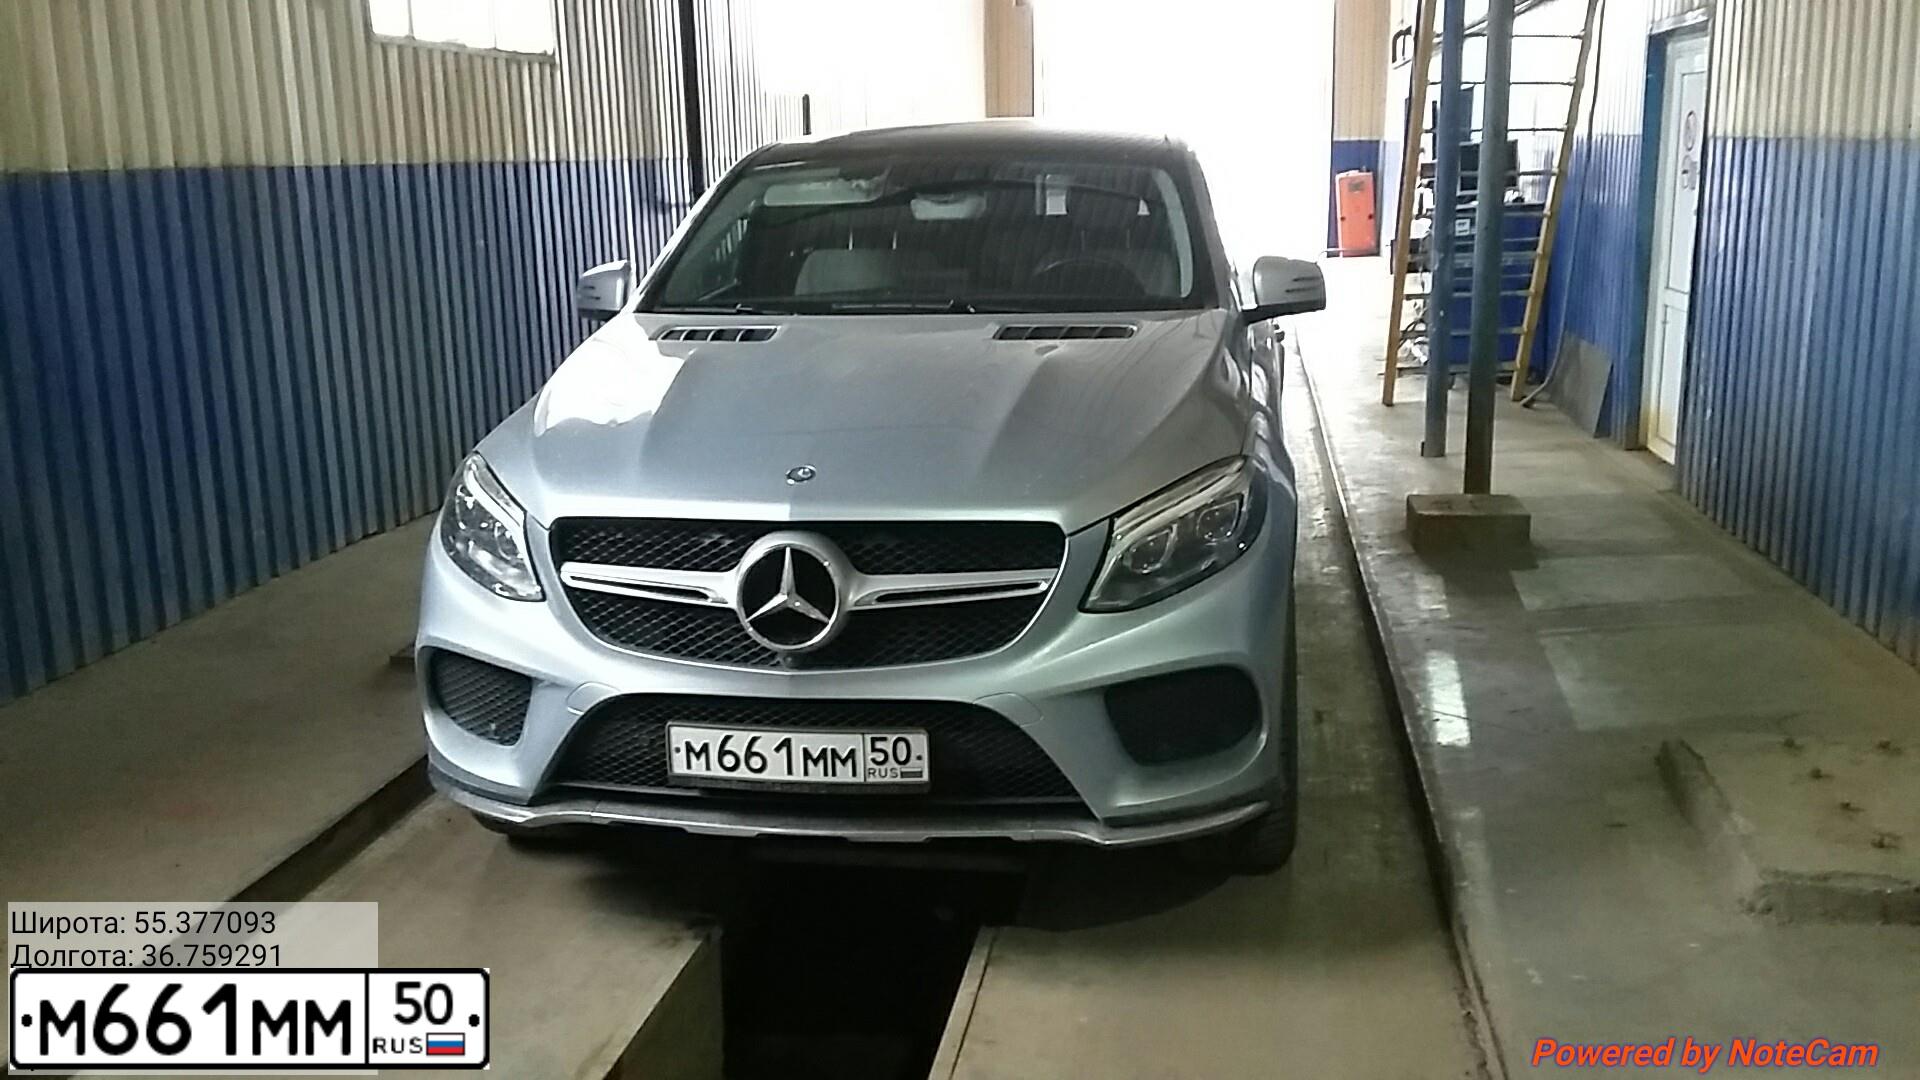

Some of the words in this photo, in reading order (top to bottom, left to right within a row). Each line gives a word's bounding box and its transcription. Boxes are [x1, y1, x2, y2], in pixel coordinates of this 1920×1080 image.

[684, 734, 858, 778] М661ММ
[869, 736, 912, 767] 50
[868, 768, 899, 779] RUS
